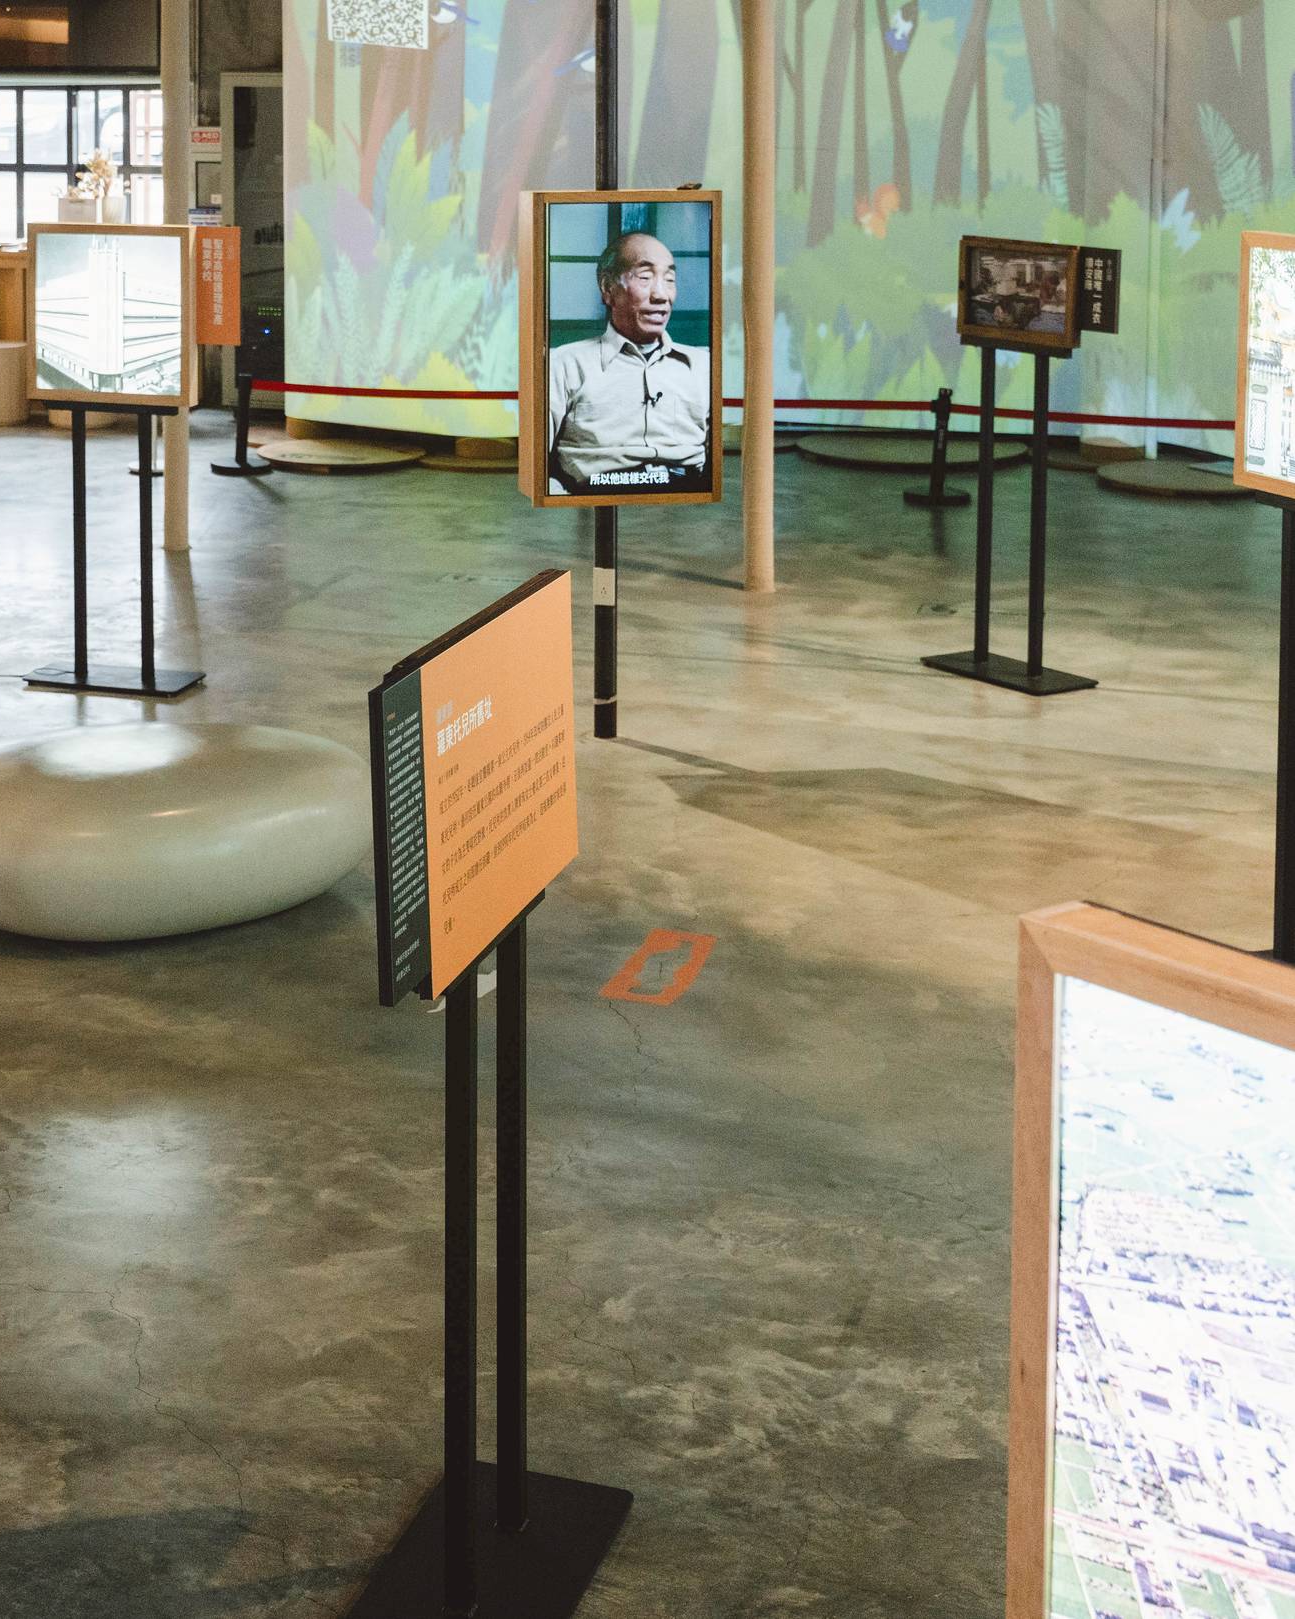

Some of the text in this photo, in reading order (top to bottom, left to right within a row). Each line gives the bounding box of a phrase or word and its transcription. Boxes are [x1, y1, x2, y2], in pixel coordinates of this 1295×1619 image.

[589, 472, 670, 486] 所以他這樣交代我
